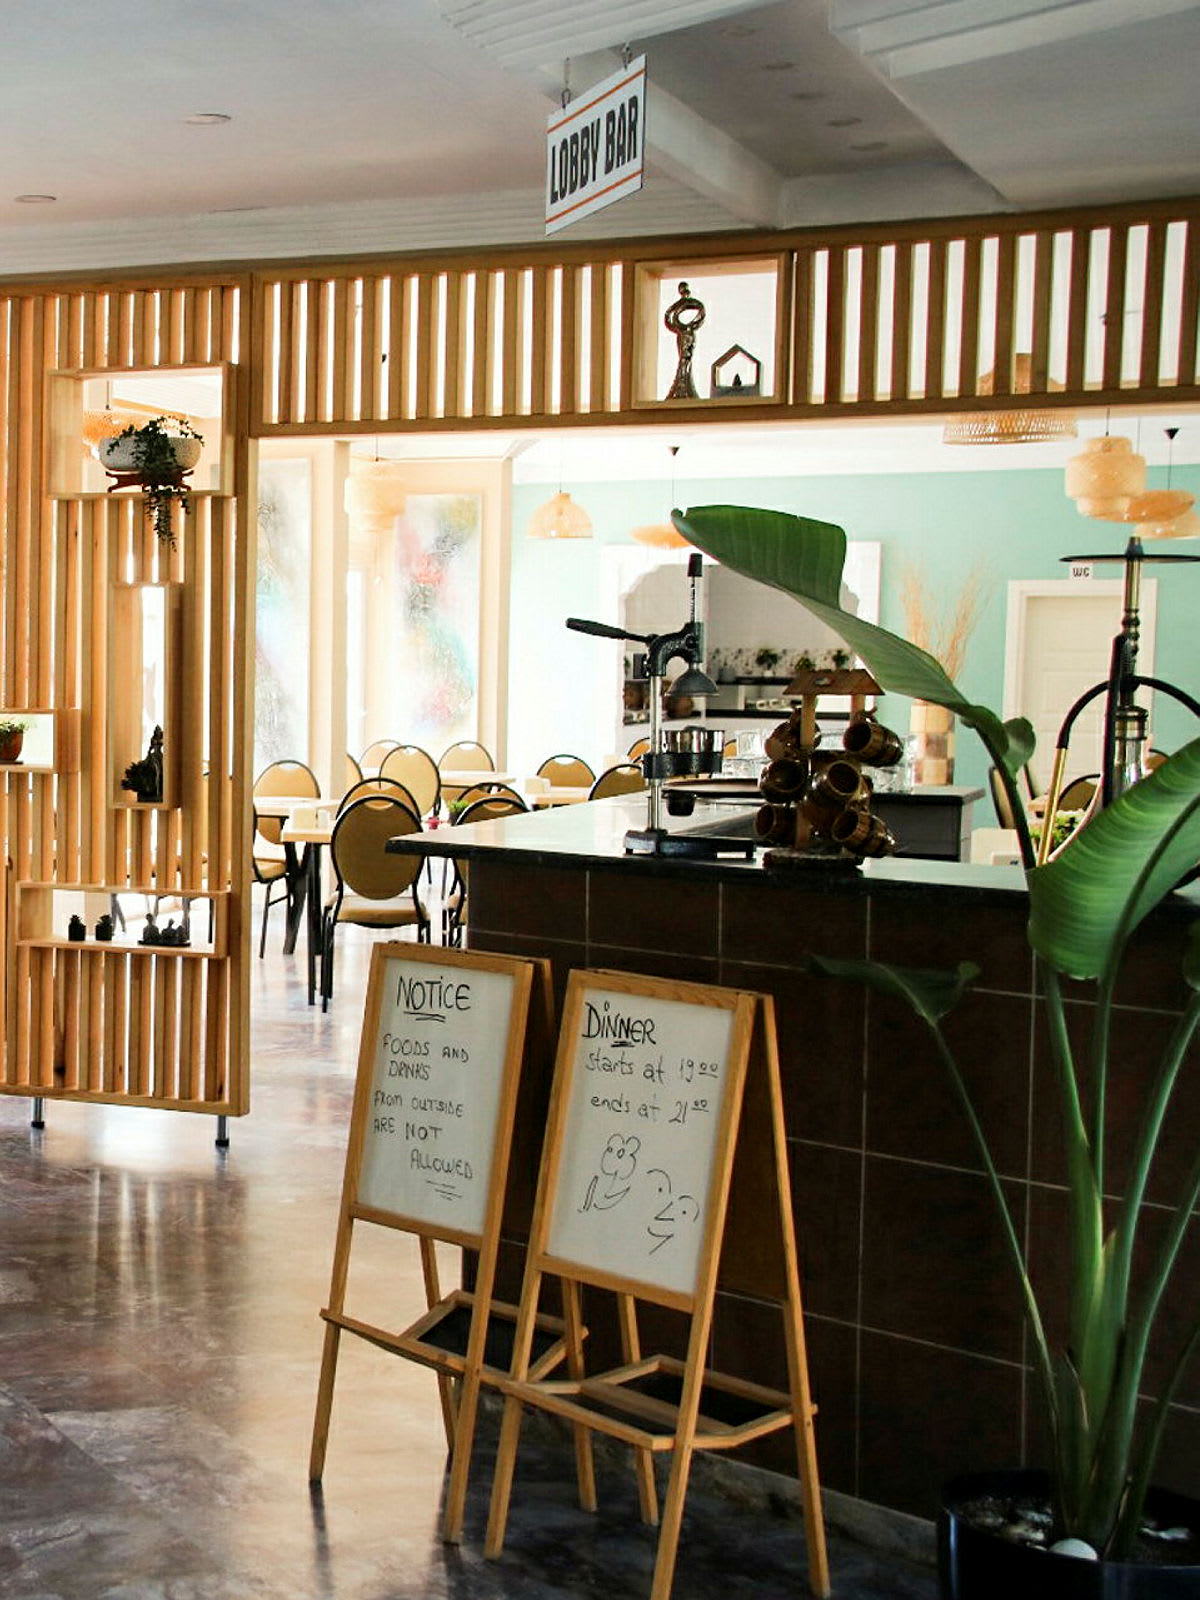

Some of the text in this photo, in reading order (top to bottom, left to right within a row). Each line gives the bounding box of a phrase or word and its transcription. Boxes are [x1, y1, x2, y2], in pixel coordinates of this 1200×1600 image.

[550, 95, 639, 204] LOBBY BAR
[1072, 567, 1090, 577] WC
[383, 1033, 469, 1063] FOODS AND
[585, 1048, 634, 1076] starts
[643, 1055, 665, 1085] at
[411, 1097, 464, 1118] OUTSIDE
[590, 1094, 631, 1113] ends
[638, 1093, 660, 1122] at
[374, 1116, 444, 1141] ARE NOT
[410, 1149, 473, 1180] ALLOWED
